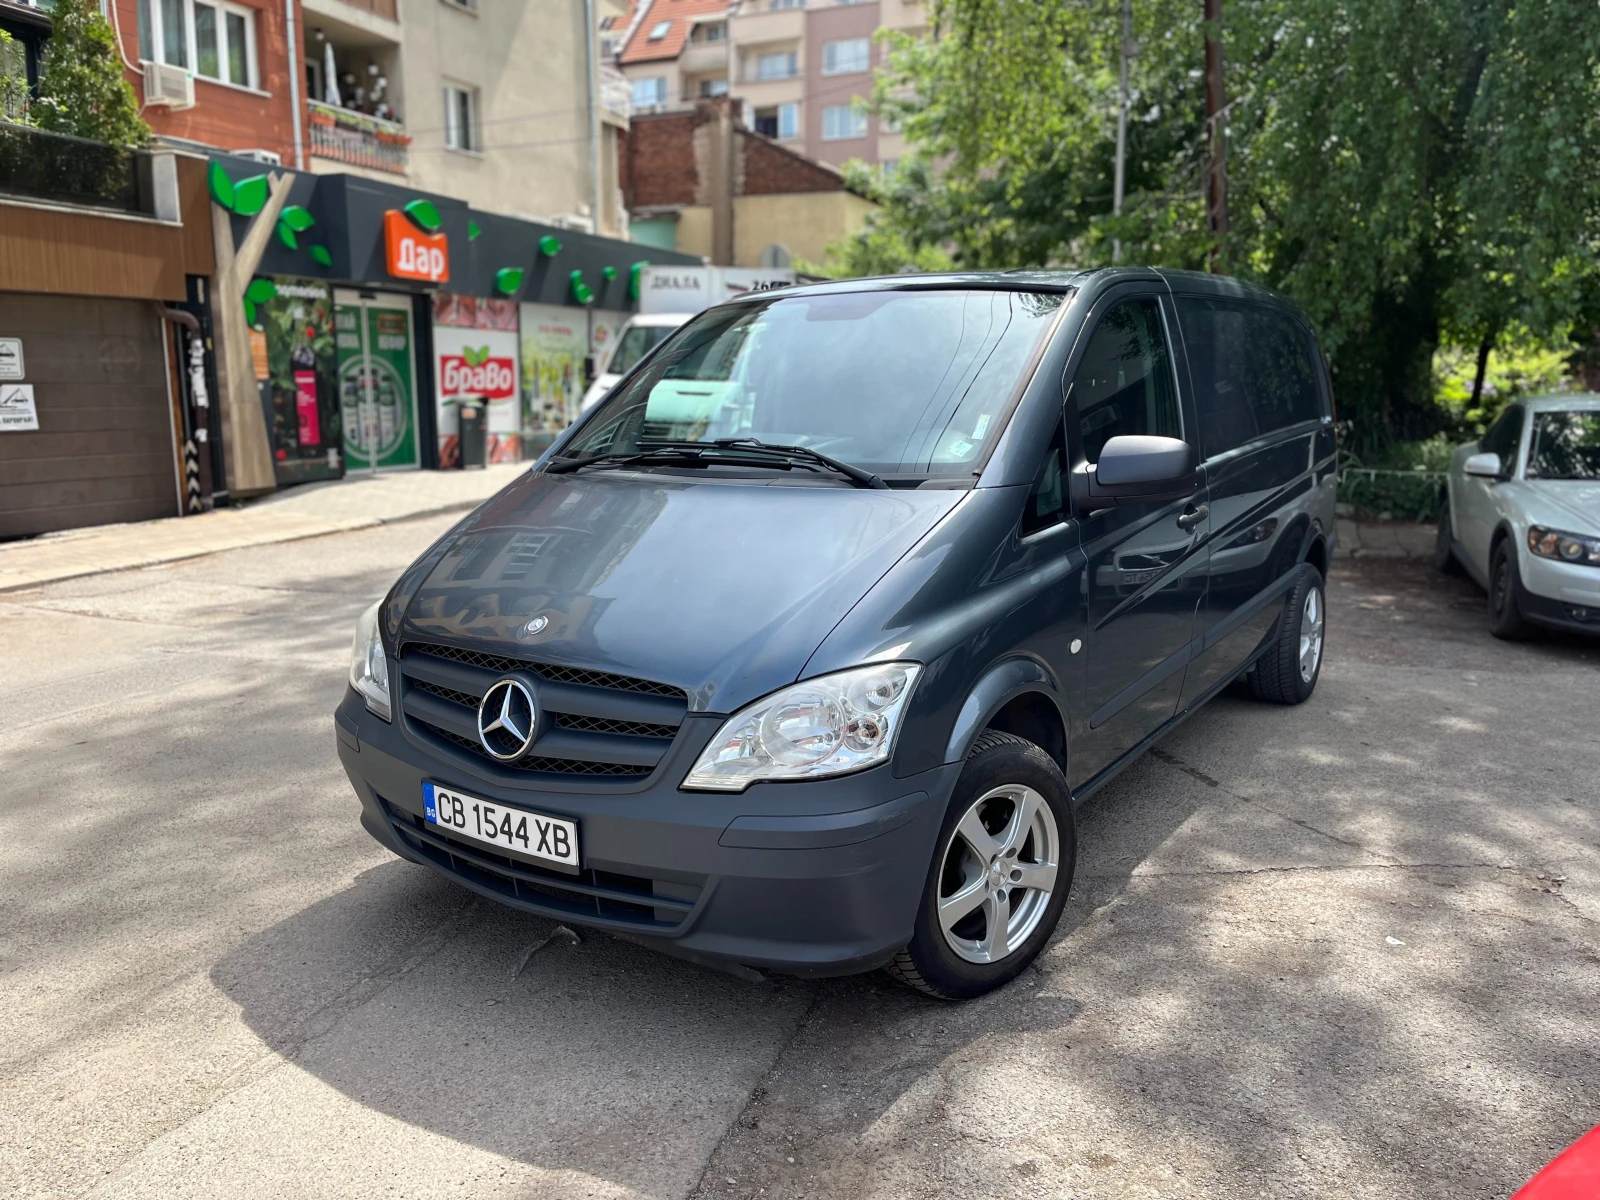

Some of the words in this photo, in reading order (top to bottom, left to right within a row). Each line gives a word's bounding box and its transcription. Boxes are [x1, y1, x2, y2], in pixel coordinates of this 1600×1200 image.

[398, 237, 445, 281] Дар
[427, 807, 436, 817] BG
[438, 792, 466, 829] CB
[473, 803, 530, 849] 1544
[535, 819, 571, 858] XB
